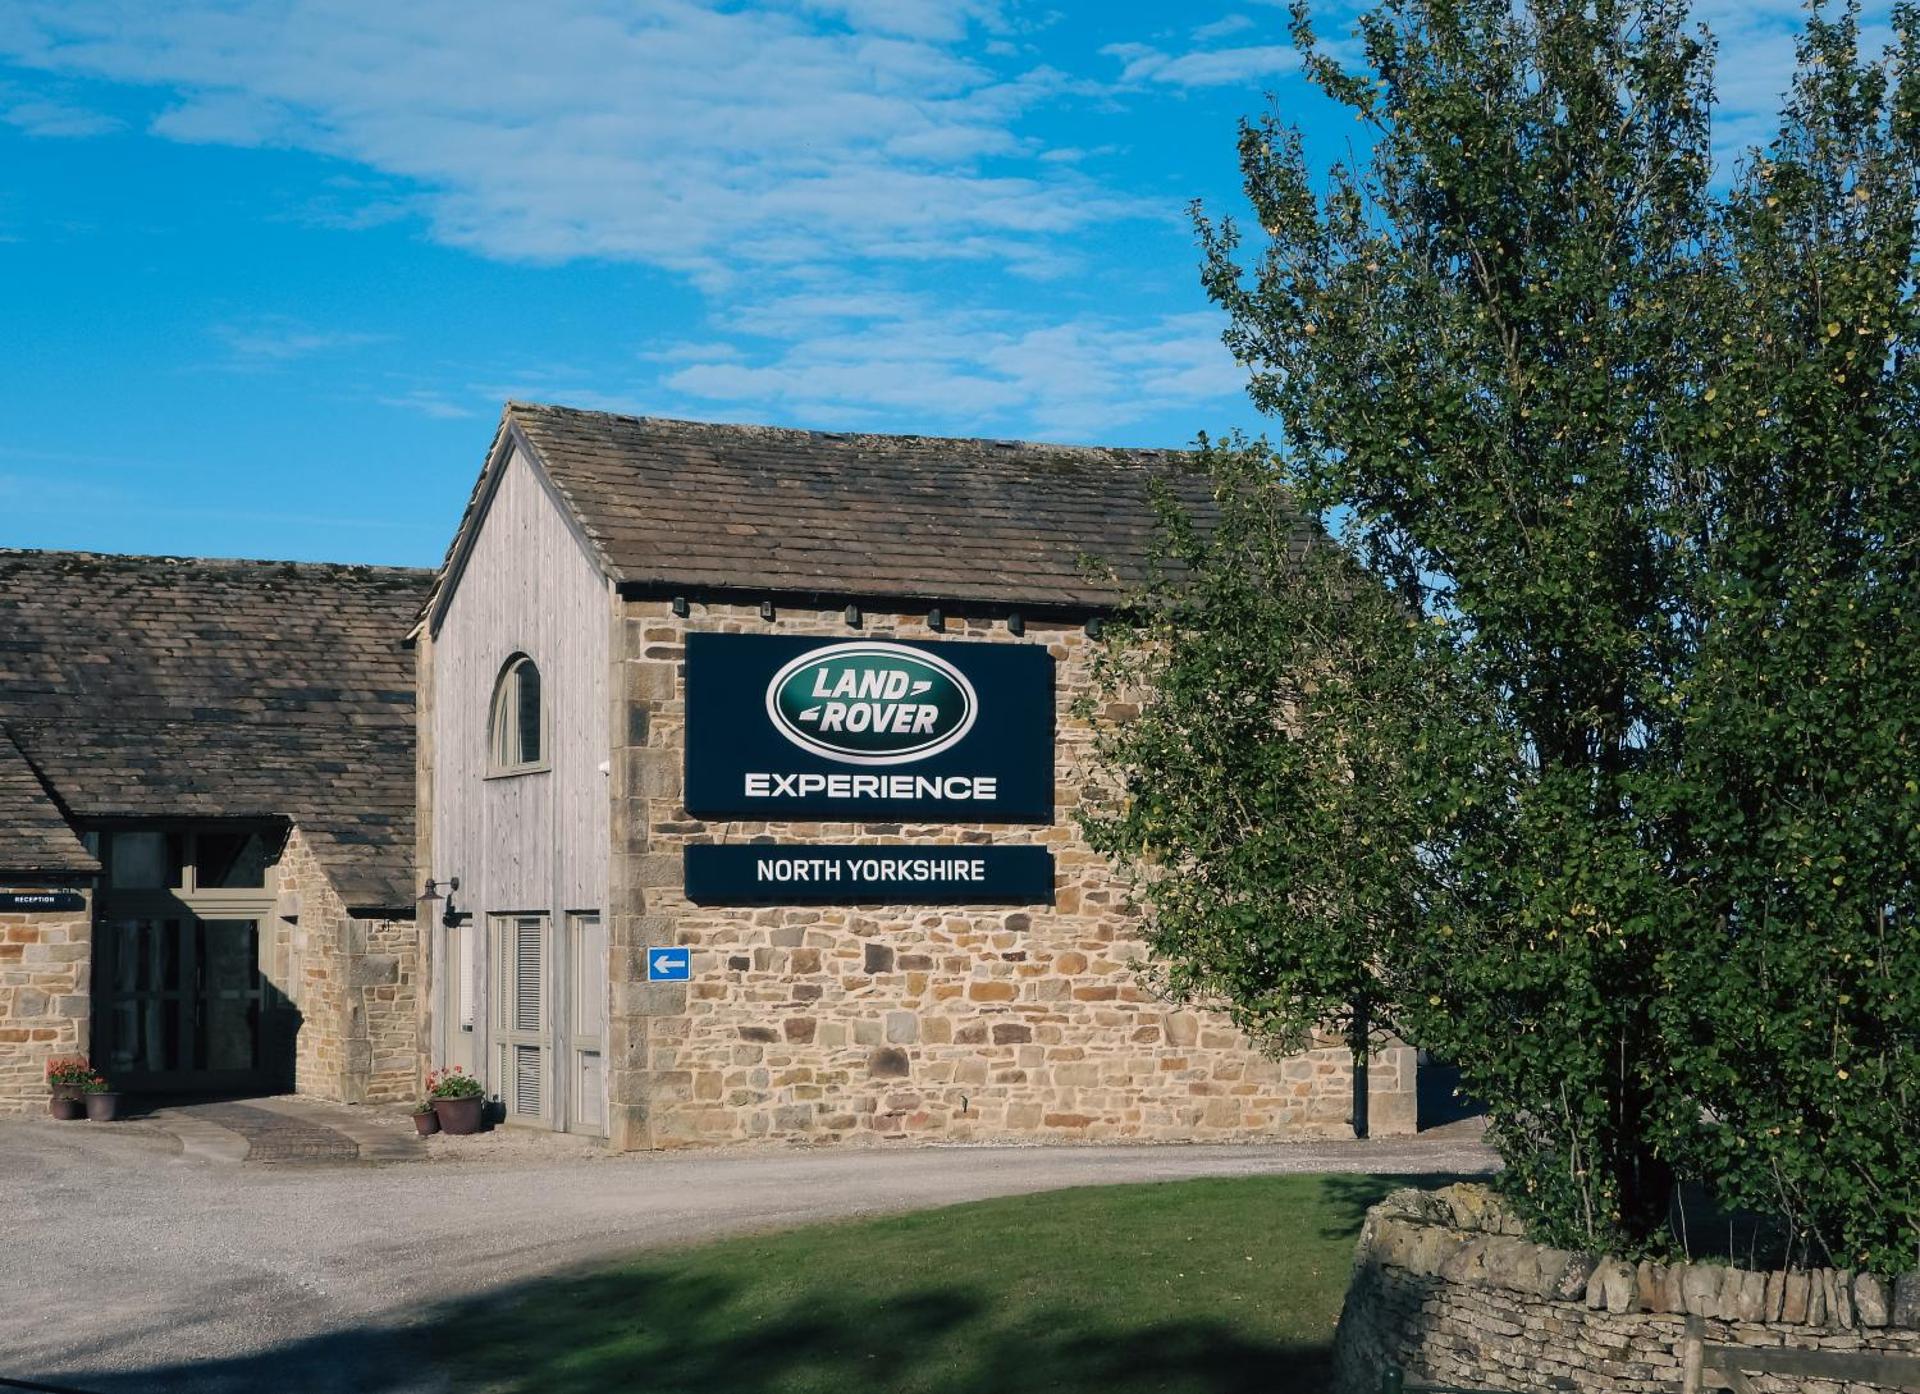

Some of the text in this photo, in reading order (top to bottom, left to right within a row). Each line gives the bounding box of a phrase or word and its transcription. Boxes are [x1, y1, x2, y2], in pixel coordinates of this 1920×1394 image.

[812, 668, 910, 699] LAND
[818, 702, 939, 734] ROVER
[745, 773, 997, 800] EXPERIENCE
[757, 859, 985, 881] NORTH YORKSHIRE
